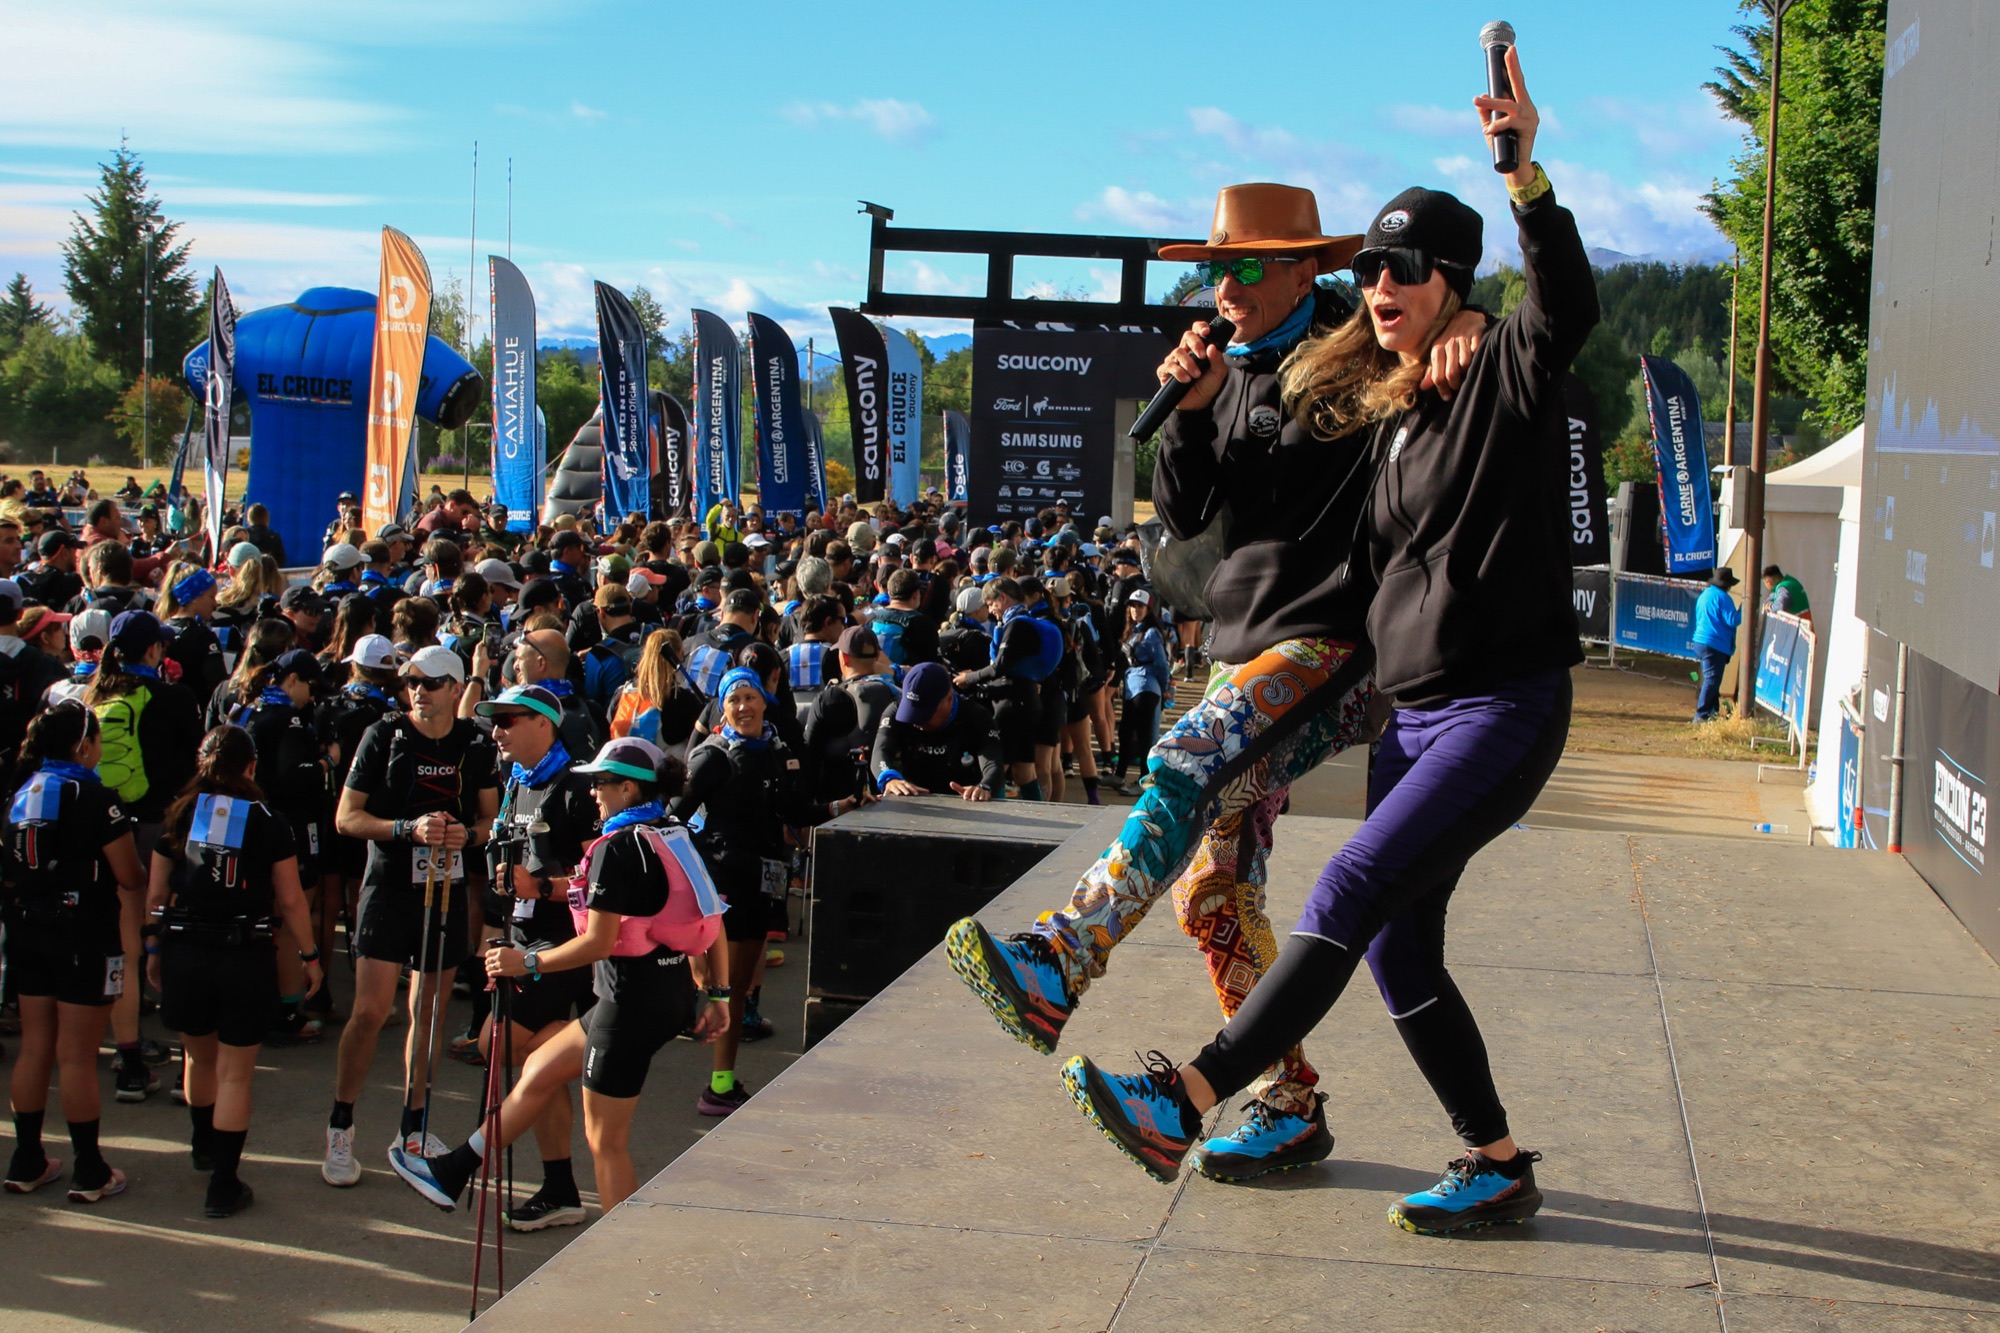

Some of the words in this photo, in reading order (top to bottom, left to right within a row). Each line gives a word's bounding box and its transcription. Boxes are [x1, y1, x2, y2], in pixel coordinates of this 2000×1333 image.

[257, 373, 278, 394] EL
[283, 375, 353, 399] CRUCE
[997, 354, 1092, 376] saucony
[505, 336, 519, 459] CAVIAHUE
[628, 381, 637, 411] Official
[711, 356, 723, 436] ARGENTINA
[768, 356, 784, 429] ARGENTINA
[892, 372, 907, 436] CRUCE
[909, 373, 918, 419] saucony
[993, 397, 1023, 411] Ford
[628, 413, 637, 453] Sponsor
[854, 355, 879, 480] saucony
[1667, 396, 1688, 469] ARGENTINA
[893, 441, 906, 464] EL
[1001, 432, 1083, 448] SAMSUNG
[666, 426, 681, 507] saucony
[710, 451, 723, 495] CARNE
[772, 443, 785, 484] CARNE
[953, 453, 966, 496] osde
[1677, 484, 1693, 526] CARNE
[1674, 553, 1684, 562] EL
[1685, 550, 1713, 561] CRUCE
[1971, 791, 1987, 847] 23
